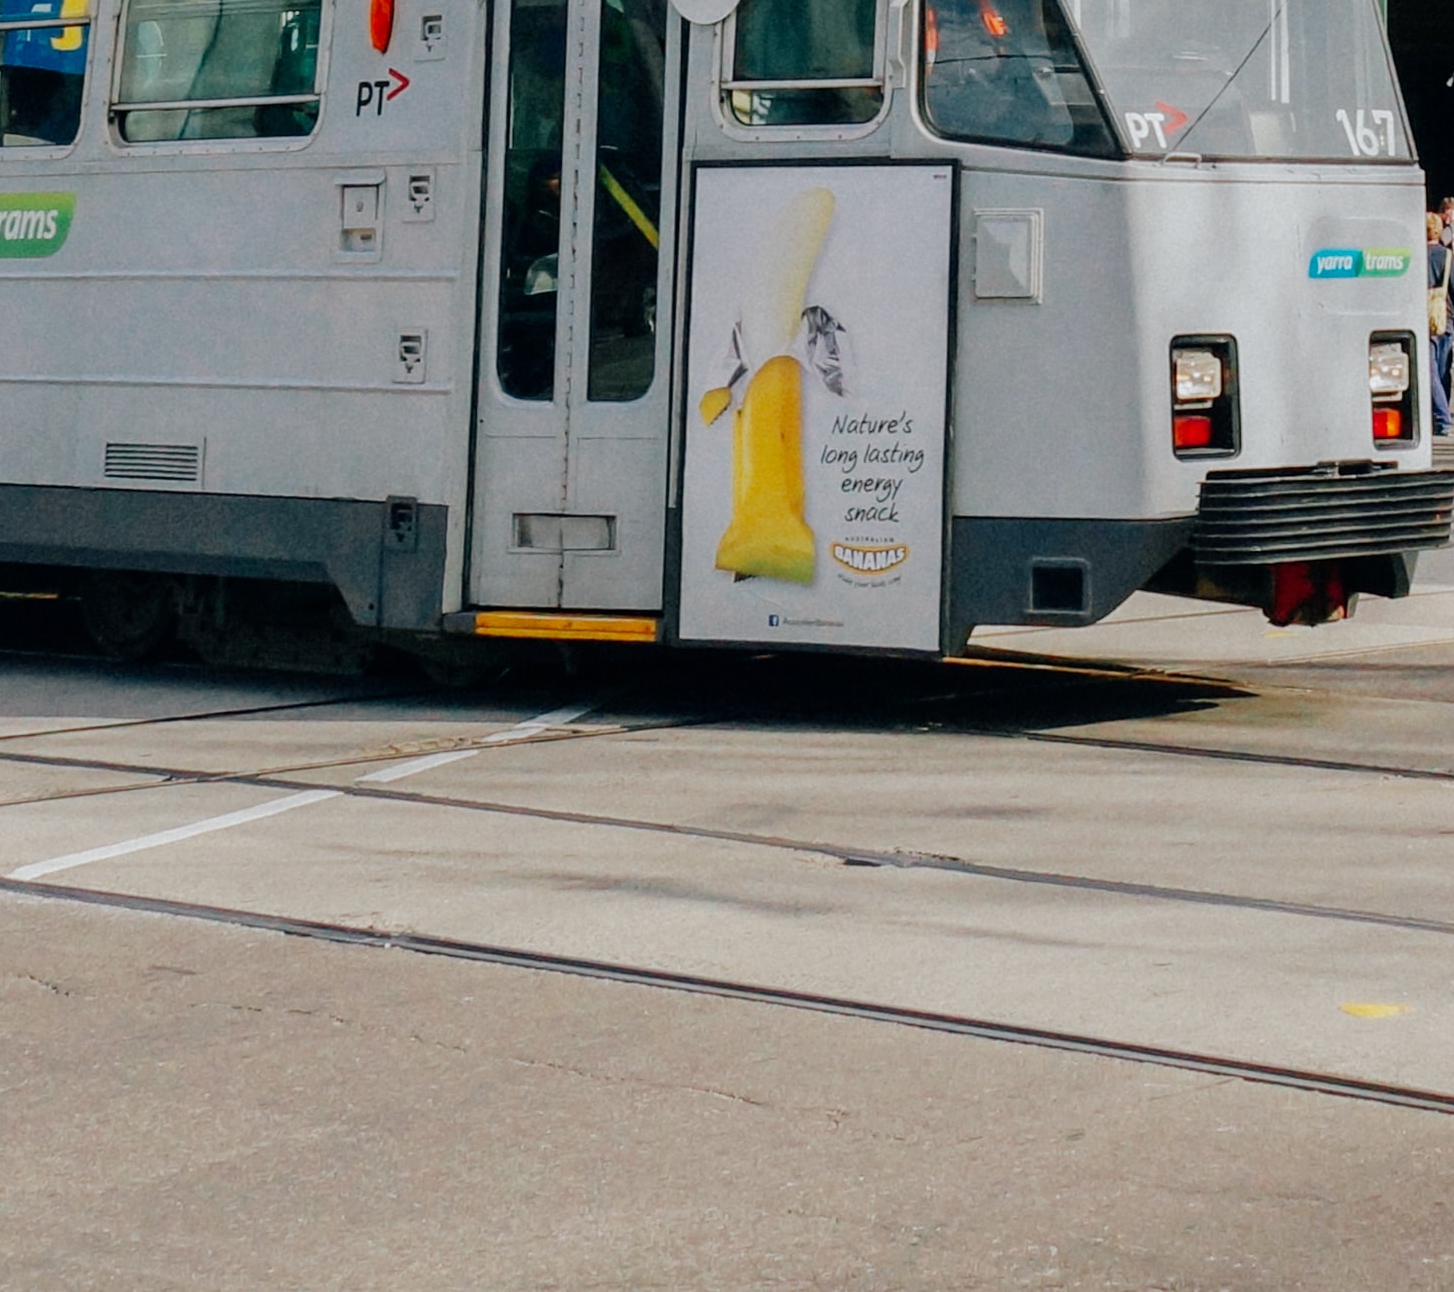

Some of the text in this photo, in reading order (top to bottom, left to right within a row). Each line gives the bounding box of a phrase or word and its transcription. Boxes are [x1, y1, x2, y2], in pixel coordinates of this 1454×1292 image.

[355, 80, 390, 117] PT
[1125, 112, 1167, 148] PT
[1336, 109, 1395, 156] 167
[1317, 253, 1404, 275] yarra trams
[831, 410, 914, 434] Nature's
[820, 441, 925, 474] long lasting
[841, 478, 903, 503] energy
[844, 502, 900, 523] snack
[834, 545, 906, 571] BANANAS
